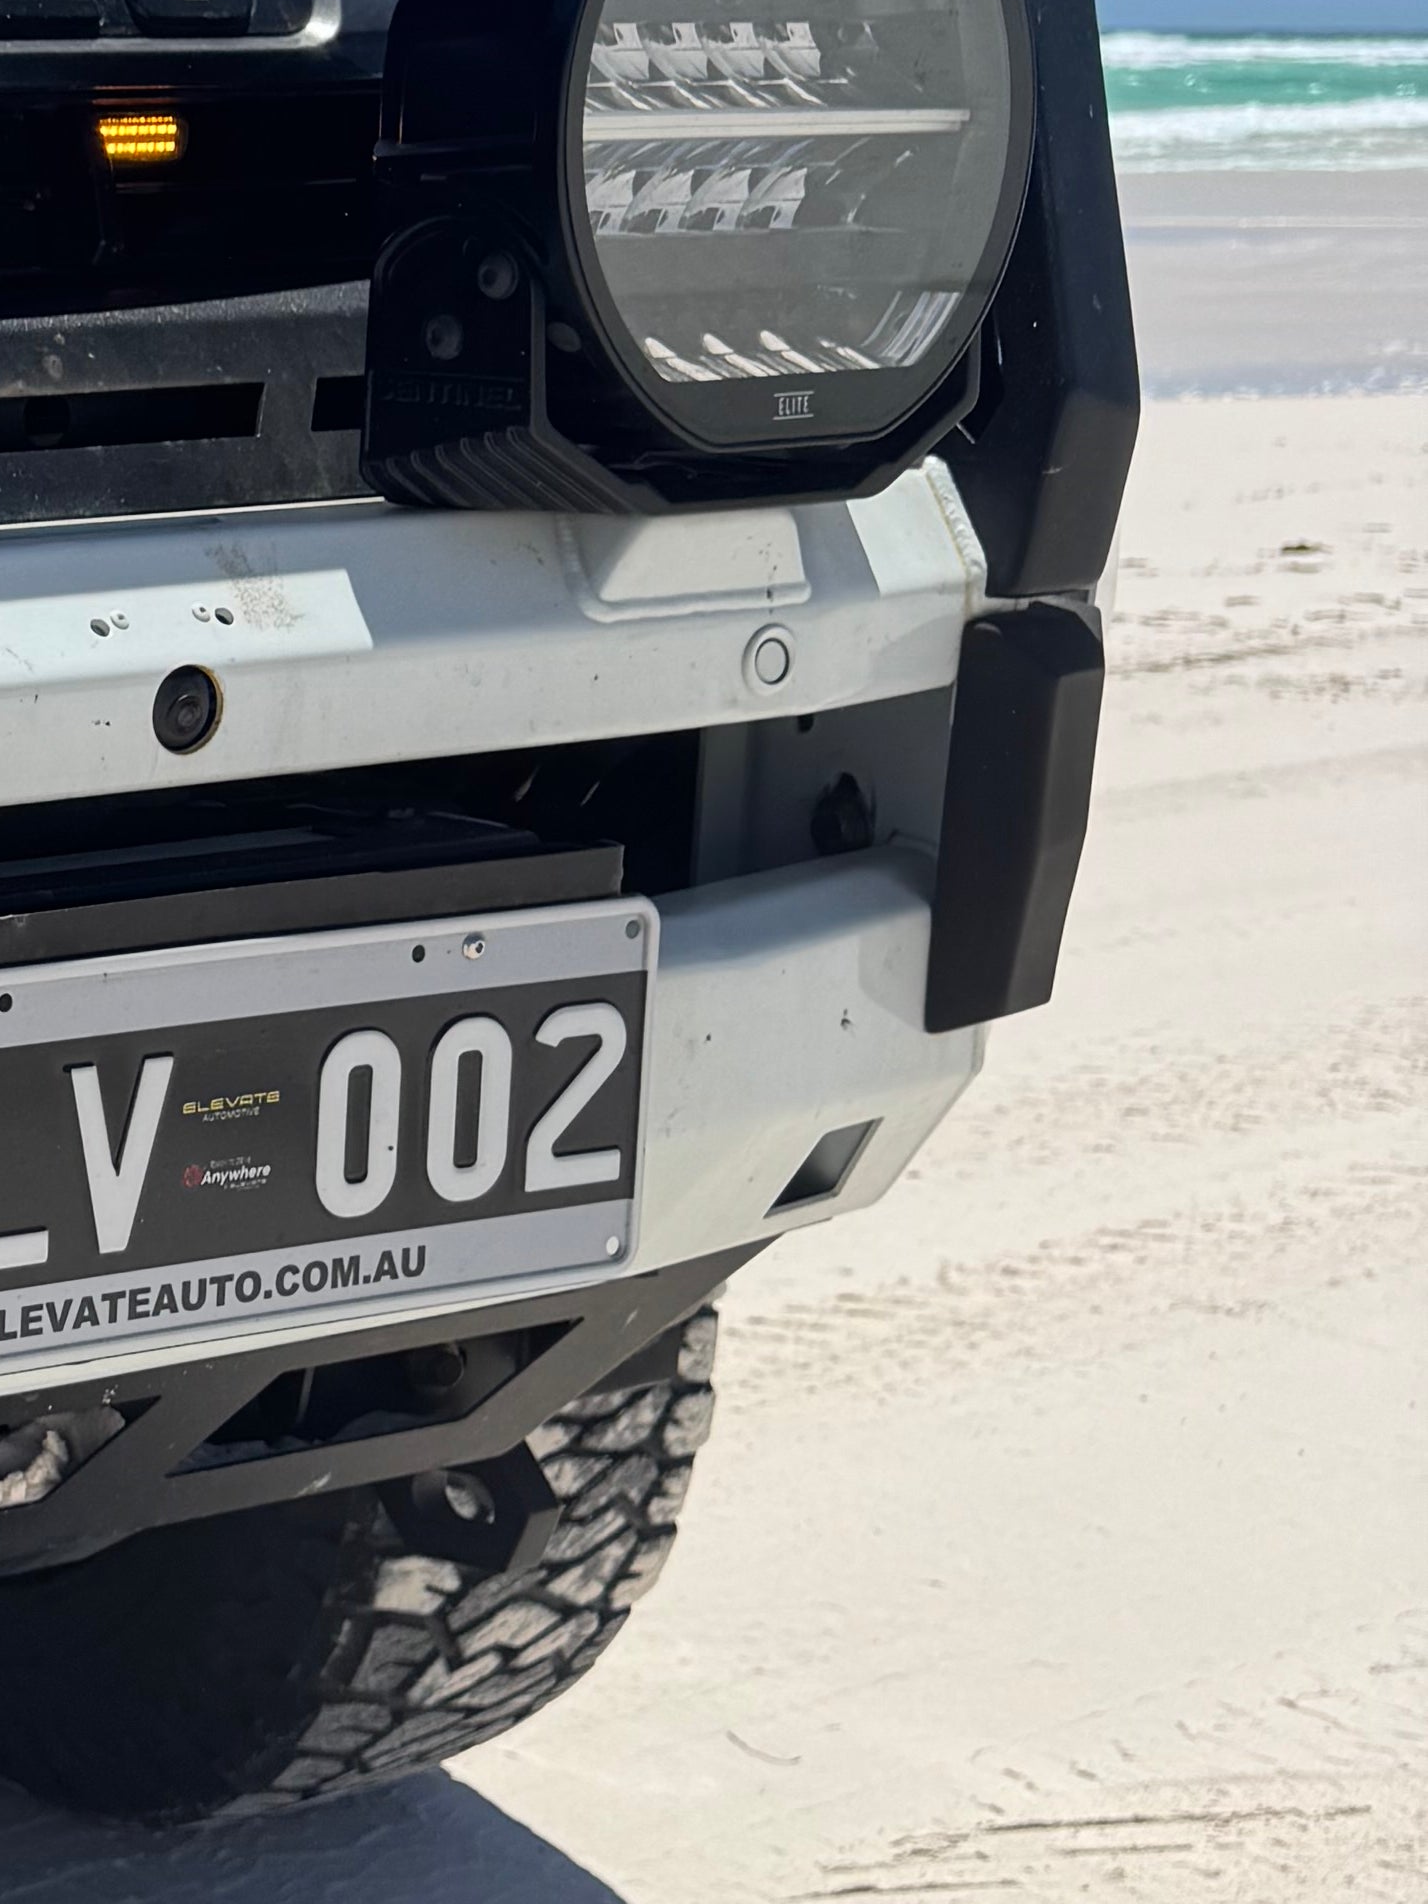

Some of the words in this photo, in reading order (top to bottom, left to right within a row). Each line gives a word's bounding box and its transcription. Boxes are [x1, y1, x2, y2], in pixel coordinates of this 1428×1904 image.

[778, 395, 810, 416] ELITE
[182, 1090, 280, 1114] ELEVATE
[315, 1001, 627, 1218] 002
[200, 1165, 272, 1186] Anywhere
